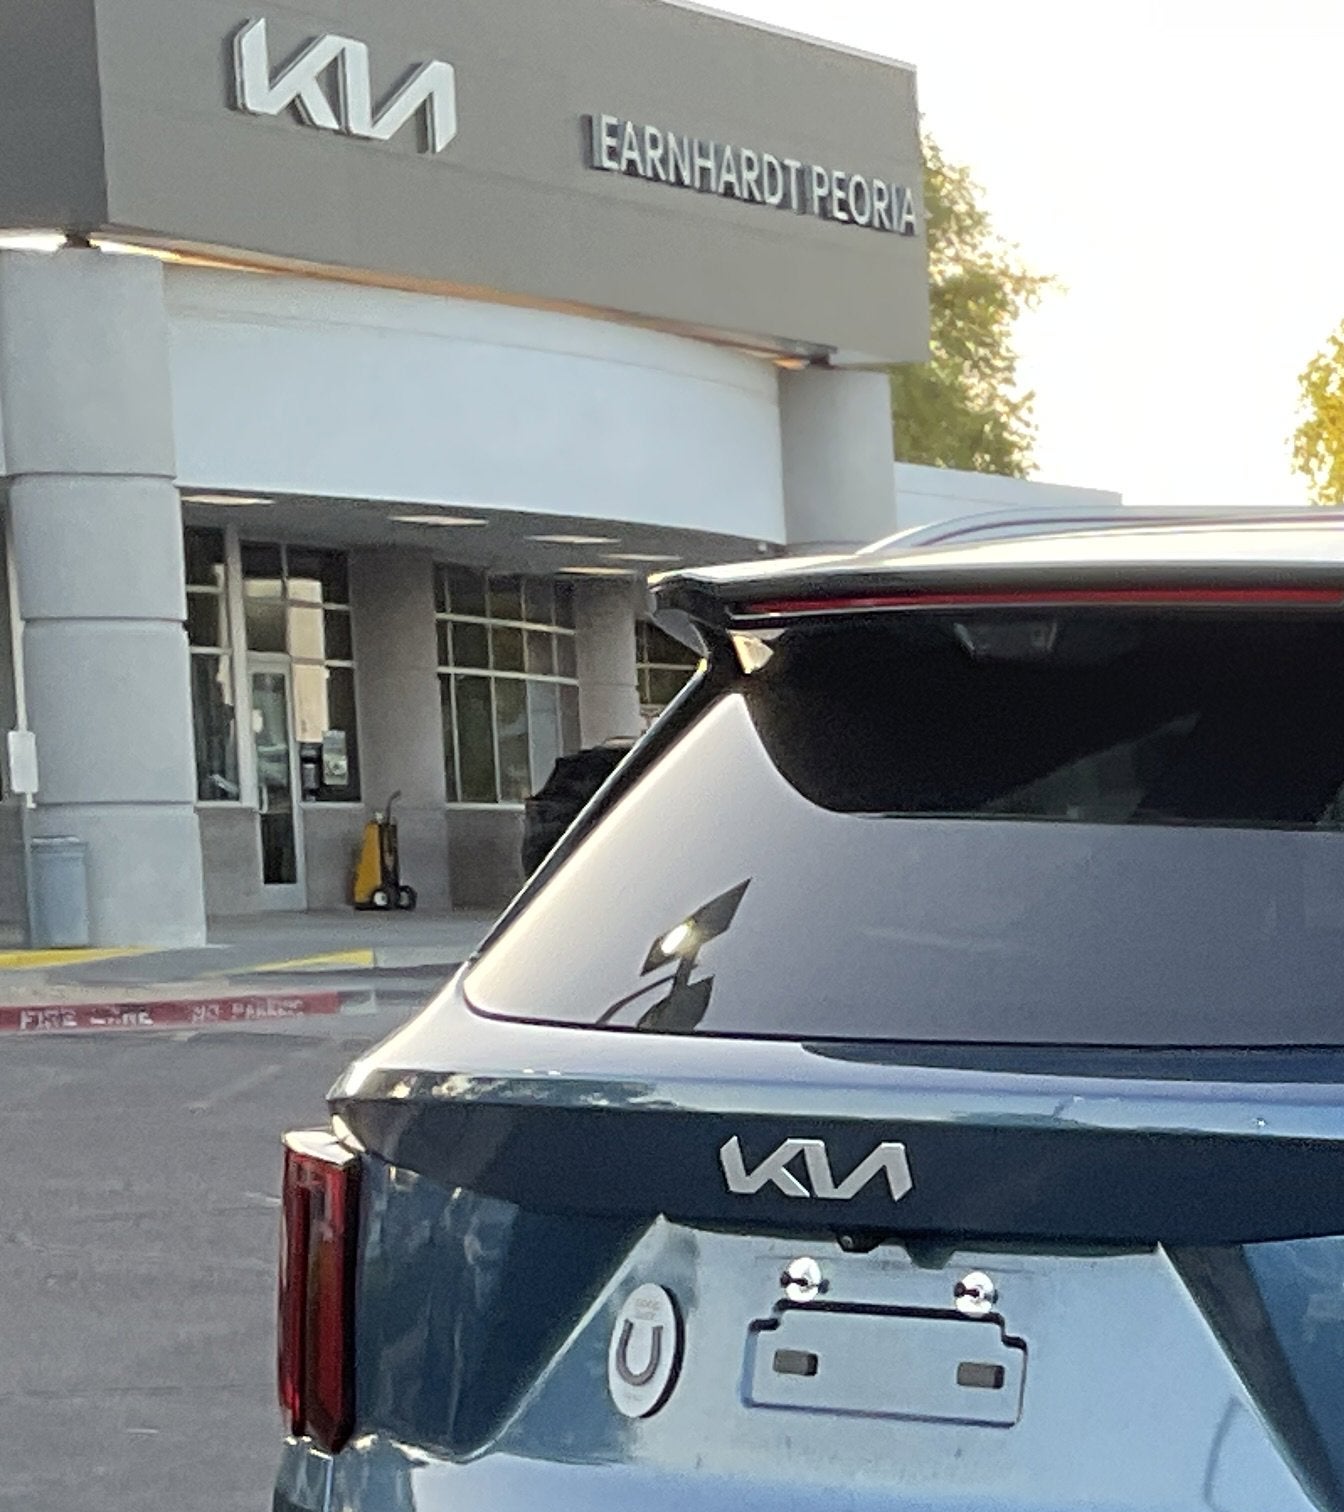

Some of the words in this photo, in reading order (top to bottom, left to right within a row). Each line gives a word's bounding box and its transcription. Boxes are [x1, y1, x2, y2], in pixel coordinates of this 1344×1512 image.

[233, 16, 457, 154] KIA
[593, 112, 802, 211] EARNHARDT
[811, 165, 917, 234] PEORIA
[719, 1134, 914, 1202] KIA
